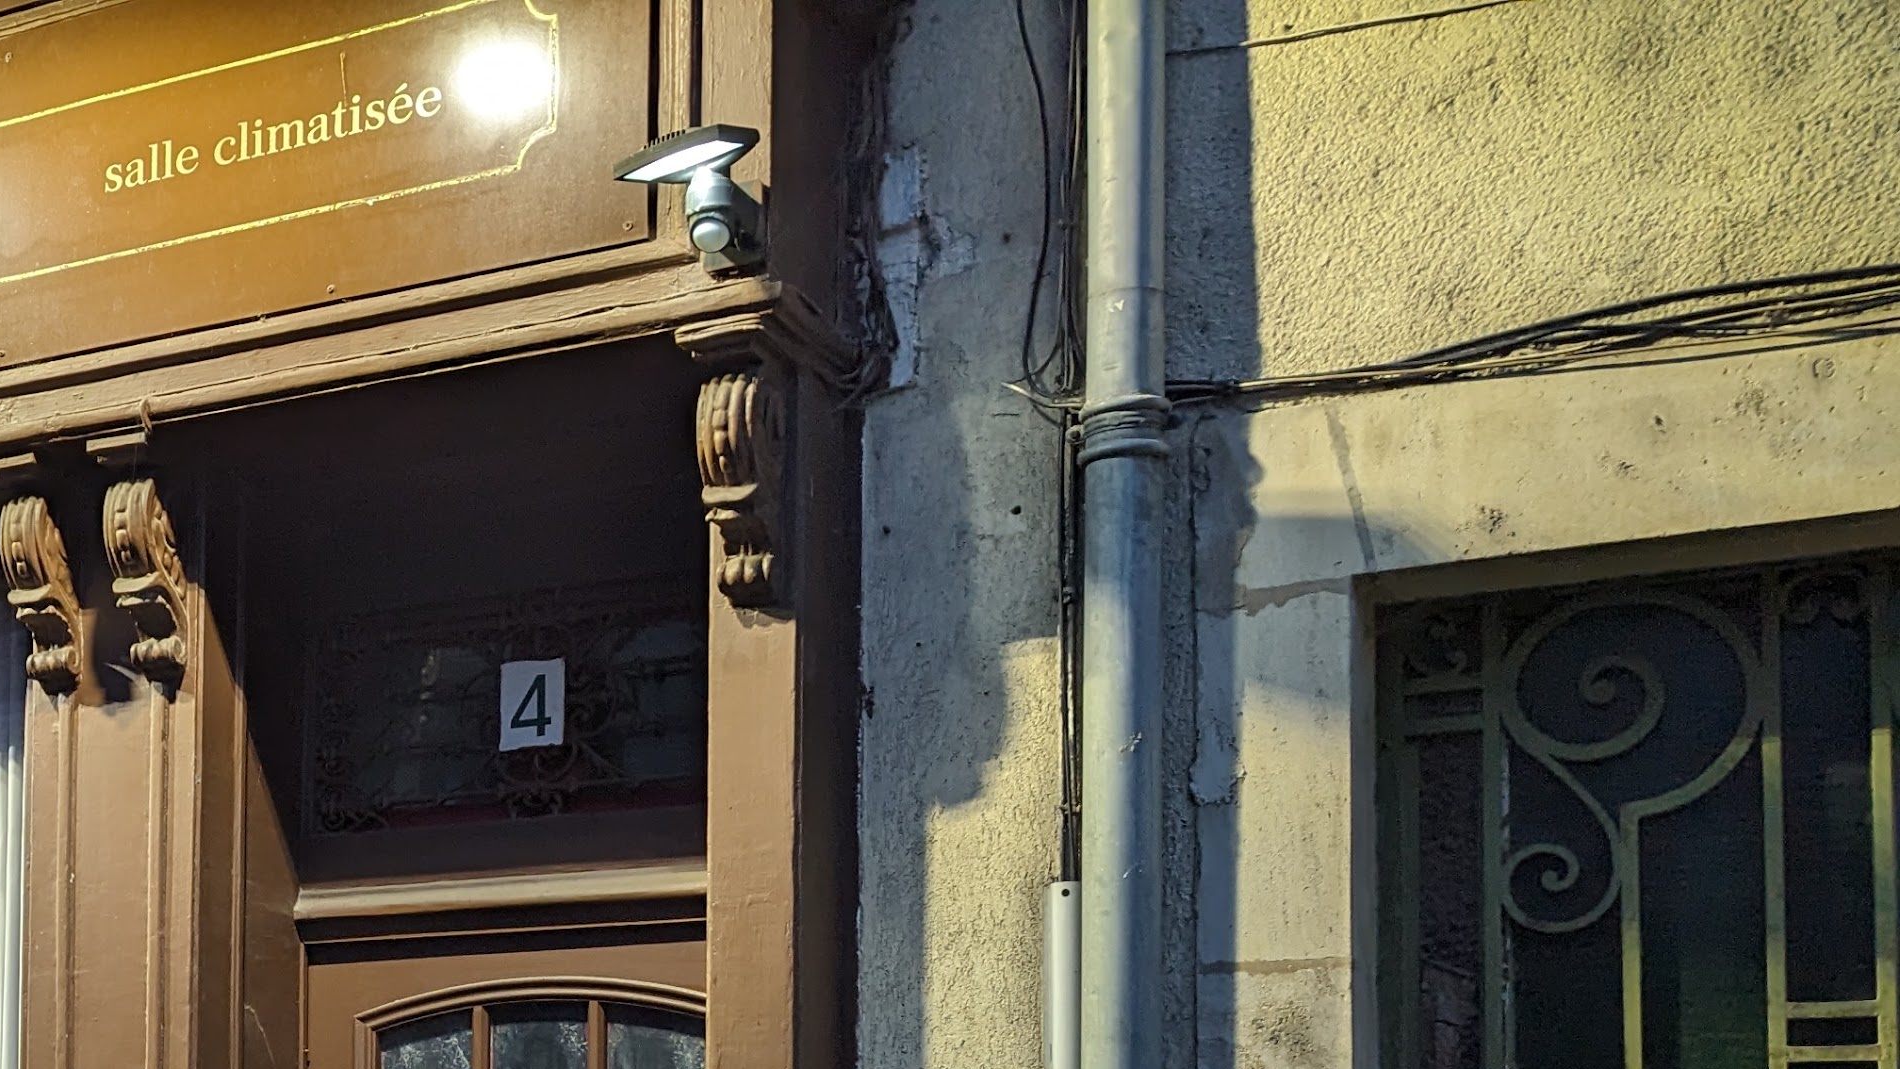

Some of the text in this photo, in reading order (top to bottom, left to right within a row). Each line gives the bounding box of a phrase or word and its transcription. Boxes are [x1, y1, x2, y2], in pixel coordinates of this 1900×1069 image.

[103, 82, 442, 193] salle climatisée
[510, 674, 552, 737] 4
